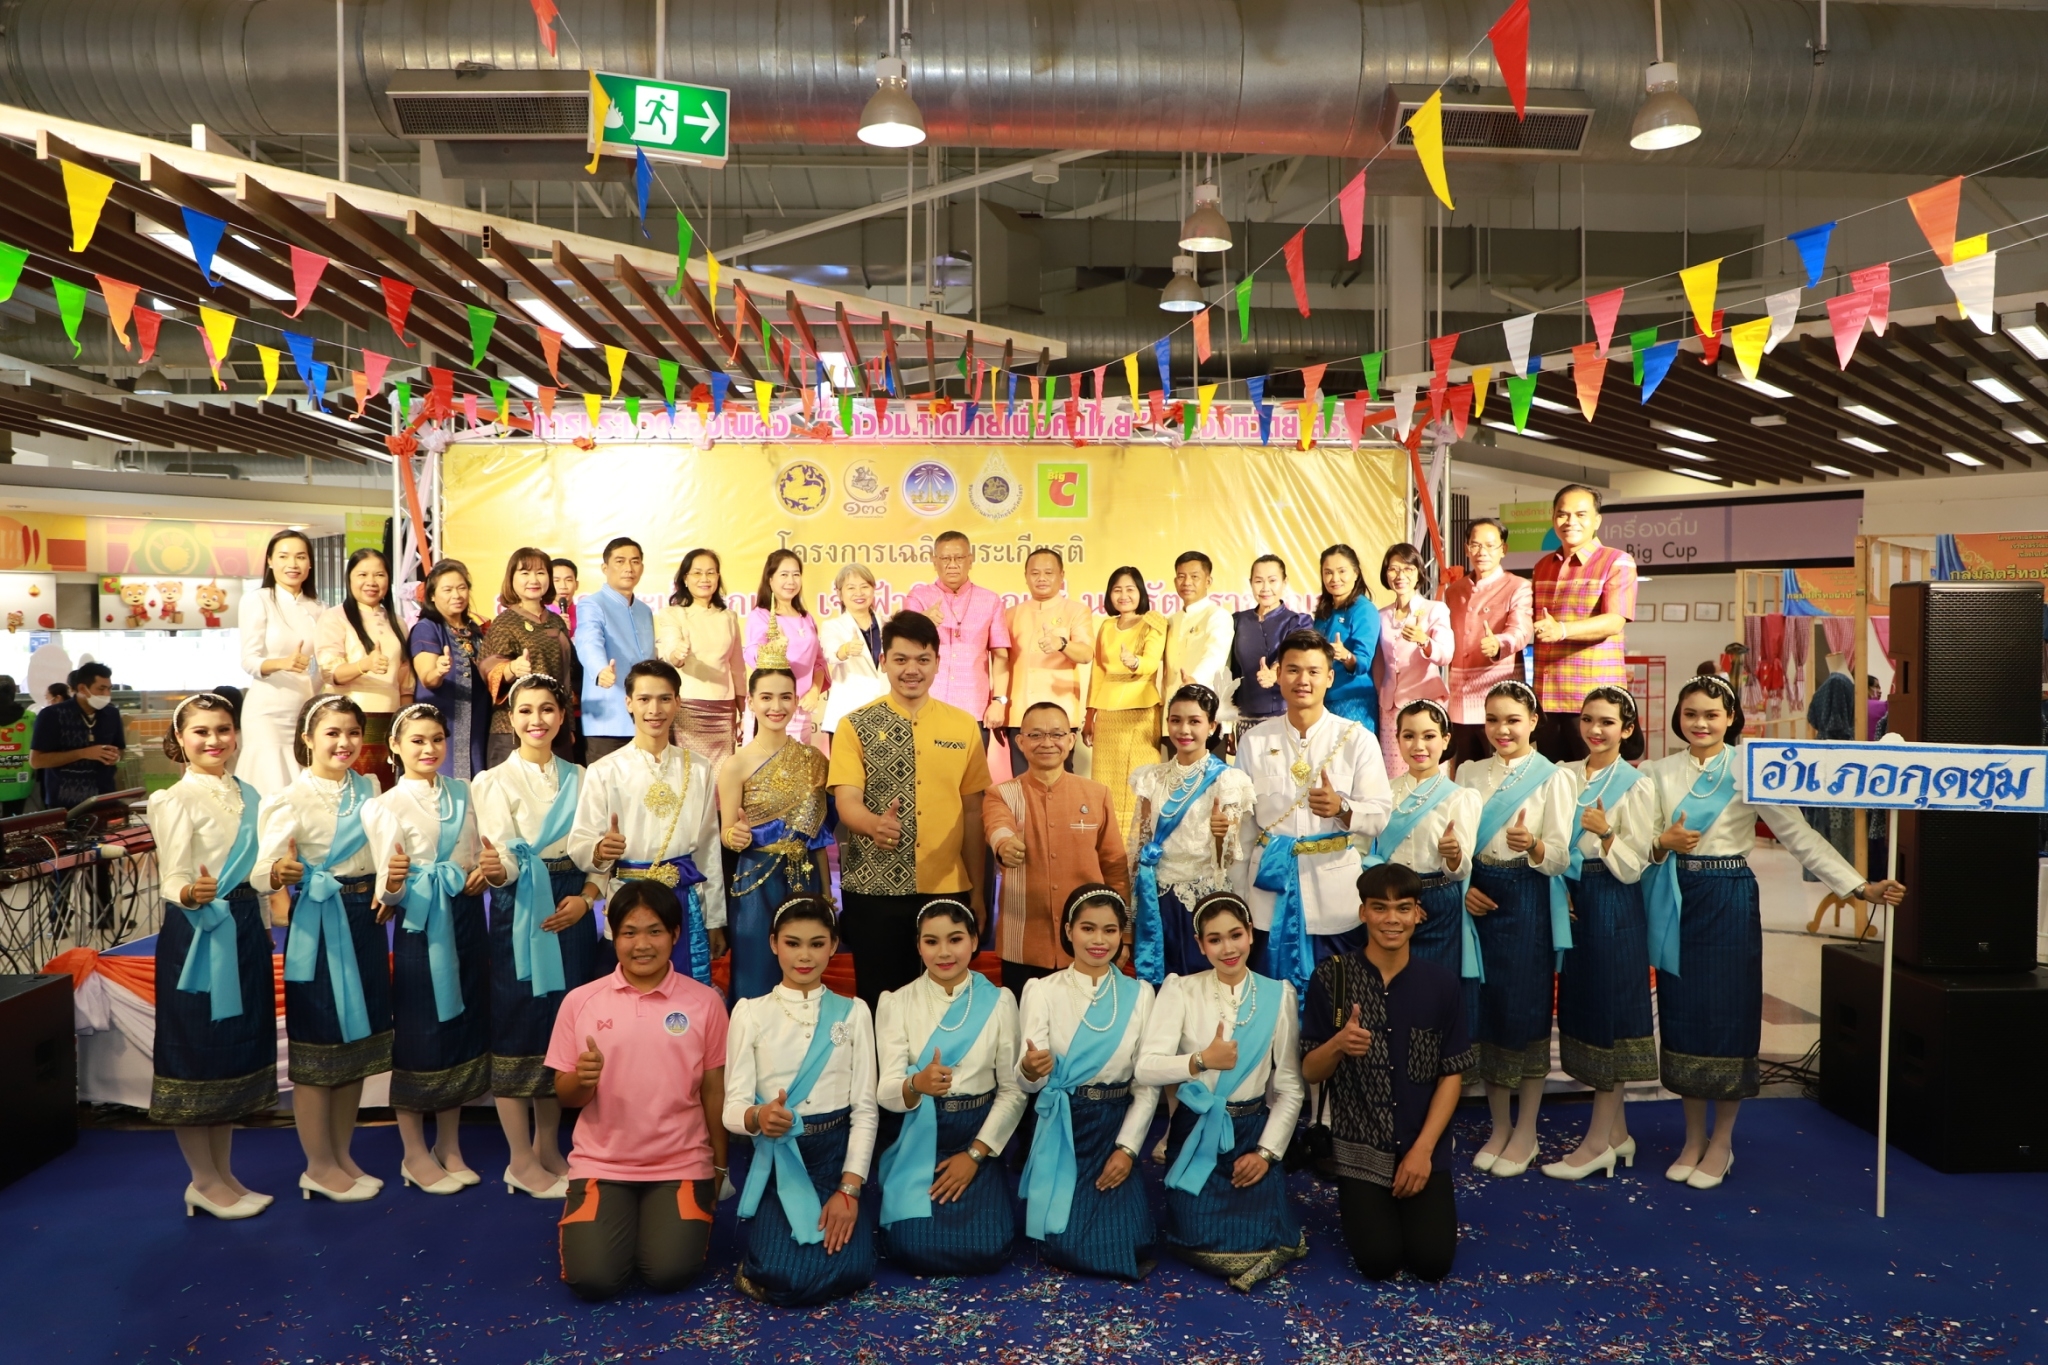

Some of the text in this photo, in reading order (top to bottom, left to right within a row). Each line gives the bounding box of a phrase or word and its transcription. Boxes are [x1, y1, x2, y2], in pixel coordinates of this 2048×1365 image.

[1604, 513, 1699, 541] เครื่องดื่ม
[1627, 541, 1698, 564] Big Cup
[1760, 747, 2035, 809] อำเภอกุดชุม
